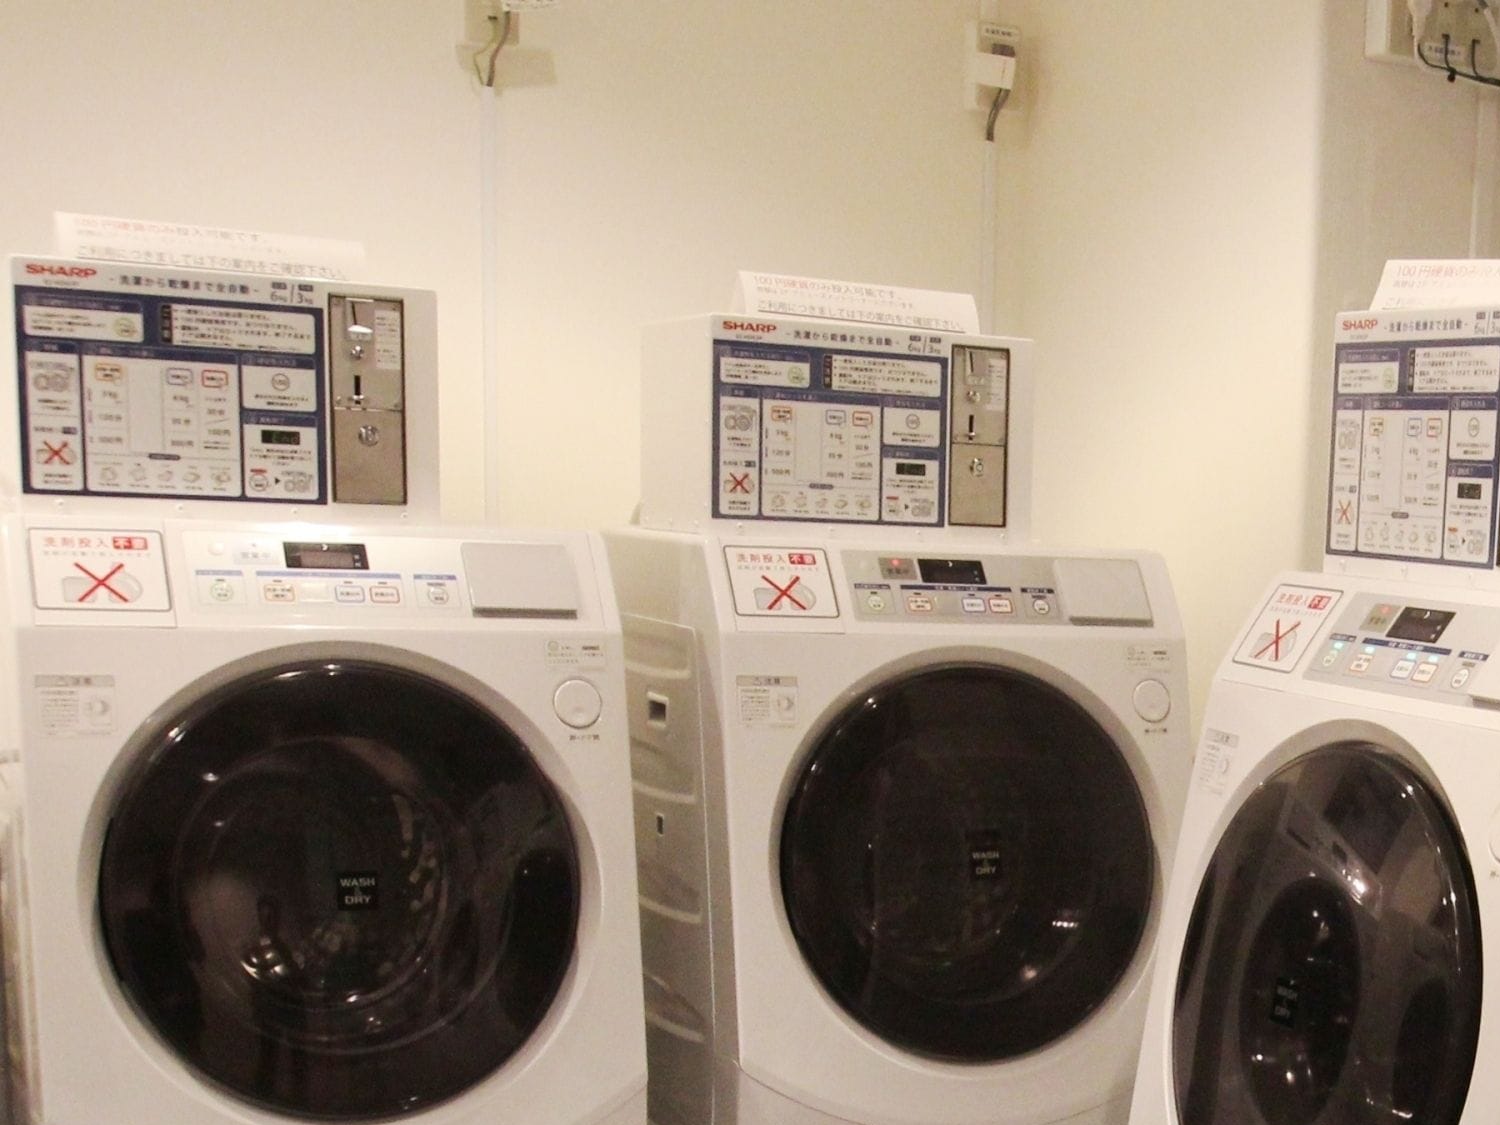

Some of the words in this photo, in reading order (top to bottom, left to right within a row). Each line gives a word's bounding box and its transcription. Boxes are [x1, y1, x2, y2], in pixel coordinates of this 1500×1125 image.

[25, 263, 98, 279] SHARP
[722, 320, 777, 334] SHARP
[1342, 319, 1378, 331] SHARP
[736, 553, 786, 566] 洗剤投入
[789, 553, 815, 566] 不要
[340, 877, 376, 887] WASH
[344, 895, 372, 905] DRY
